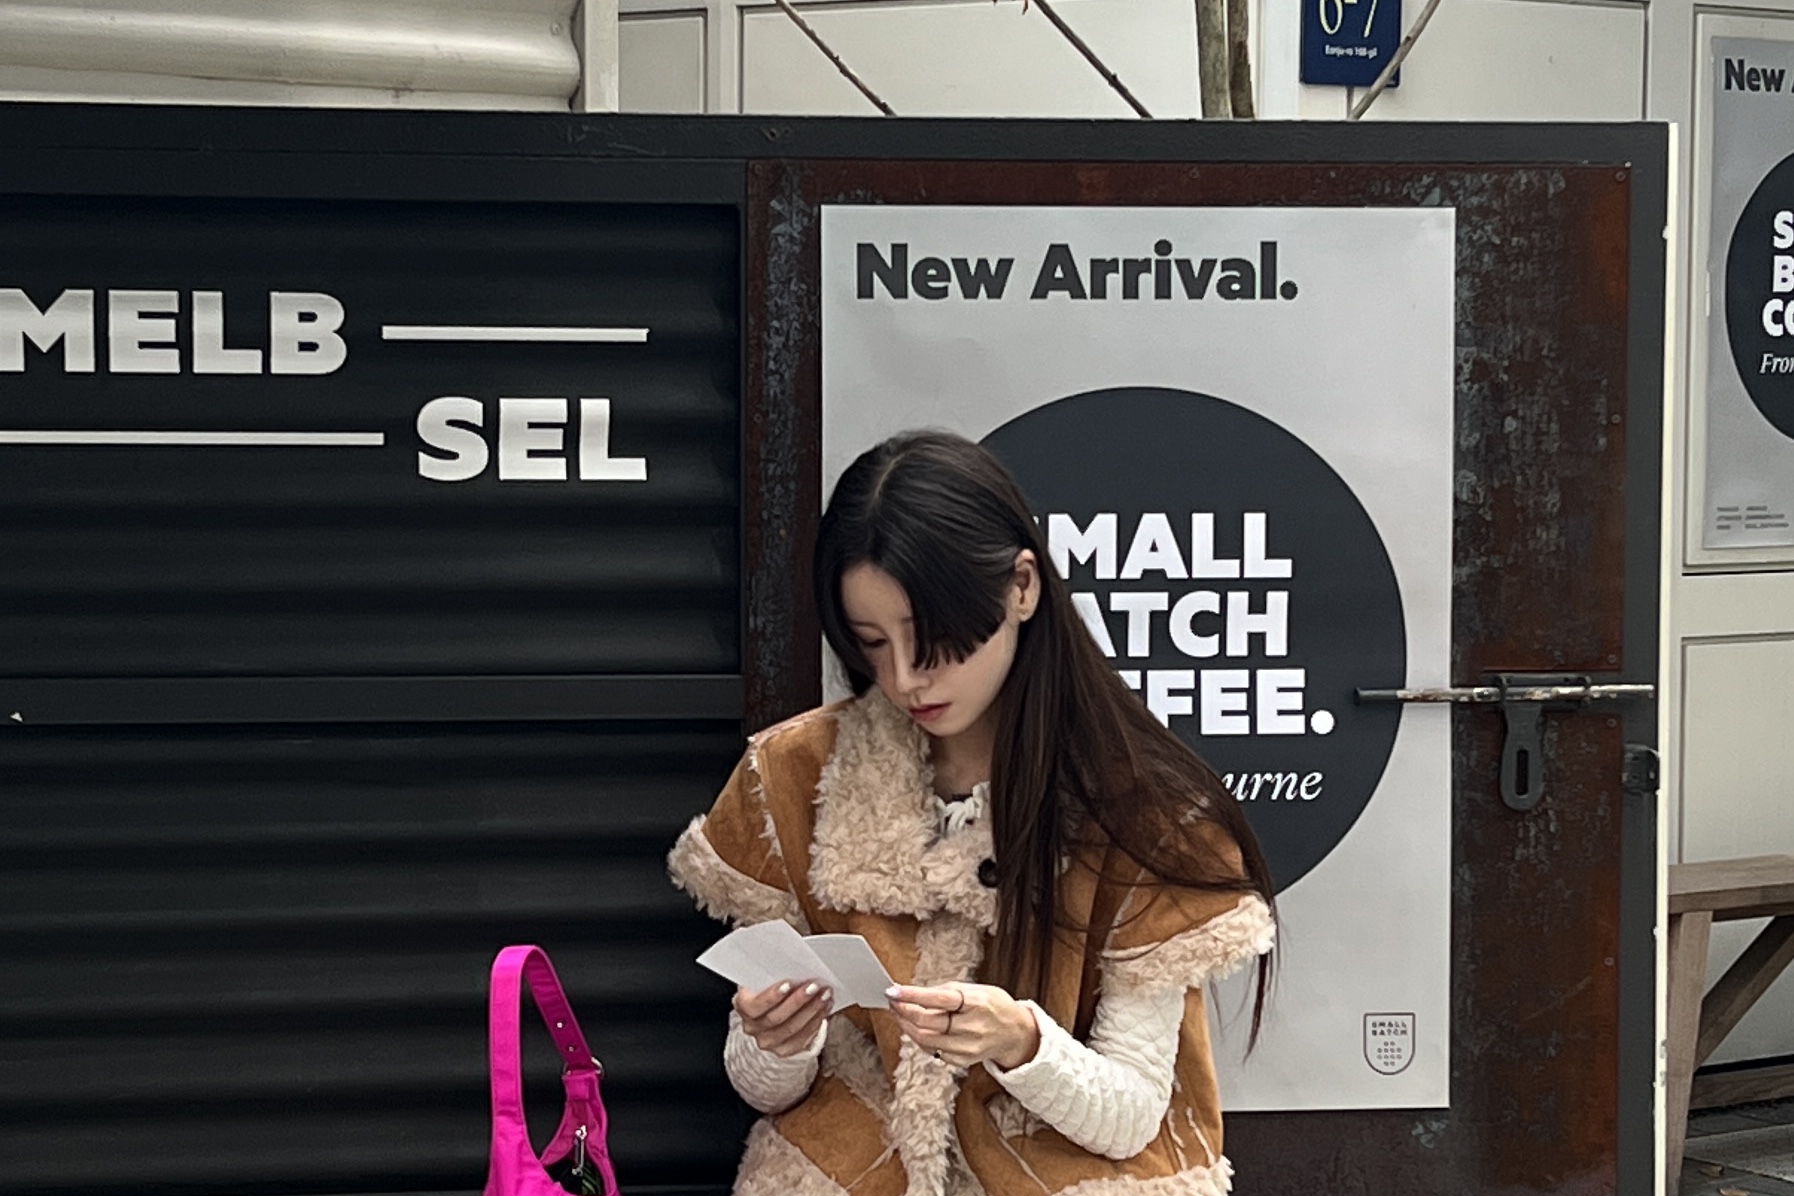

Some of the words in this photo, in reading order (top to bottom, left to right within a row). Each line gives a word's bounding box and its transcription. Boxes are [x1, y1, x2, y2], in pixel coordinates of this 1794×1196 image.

[1724, 58, 1786, 93] New
[856, 242, 1015, 301] New
[1029, 238, 1299, 301] Arrival.
[0, 288, 348, 375] MELB
[416, 396, 648, 482] SEL
[1034, 511, 1293, 580] MALL
[1070, 590, 1290, 658] ATCH
